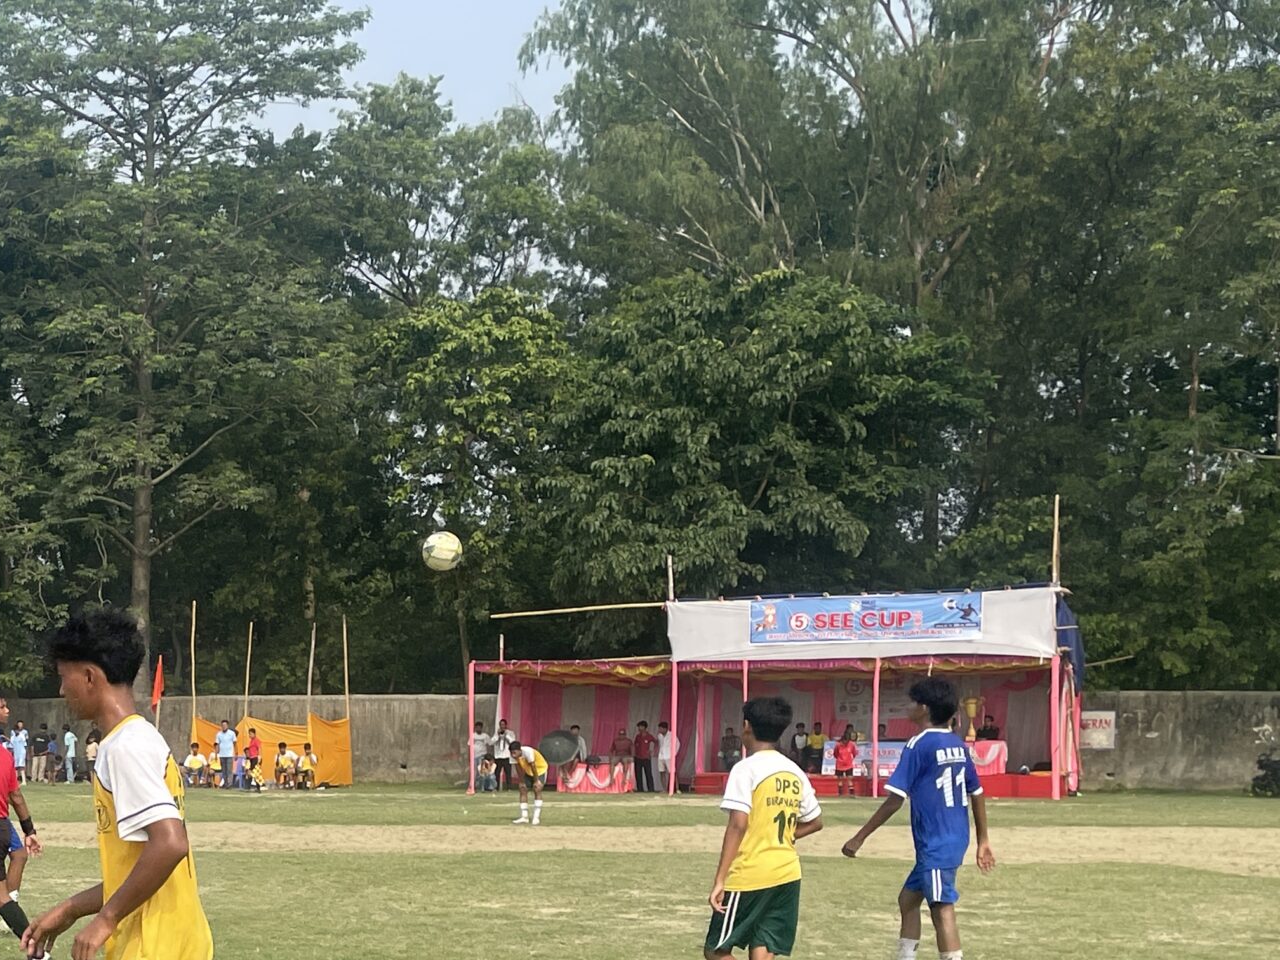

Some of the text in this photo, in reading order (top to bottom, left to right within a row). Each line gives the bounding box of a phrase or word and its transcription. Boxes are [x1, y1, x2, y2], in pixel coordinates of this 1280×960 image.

[814, 612, 854, 629] SEE
[860, 611, 912, 628] CUP
[775, 777, 800, 795] DPS
[936, 766, 968, 807] 11
